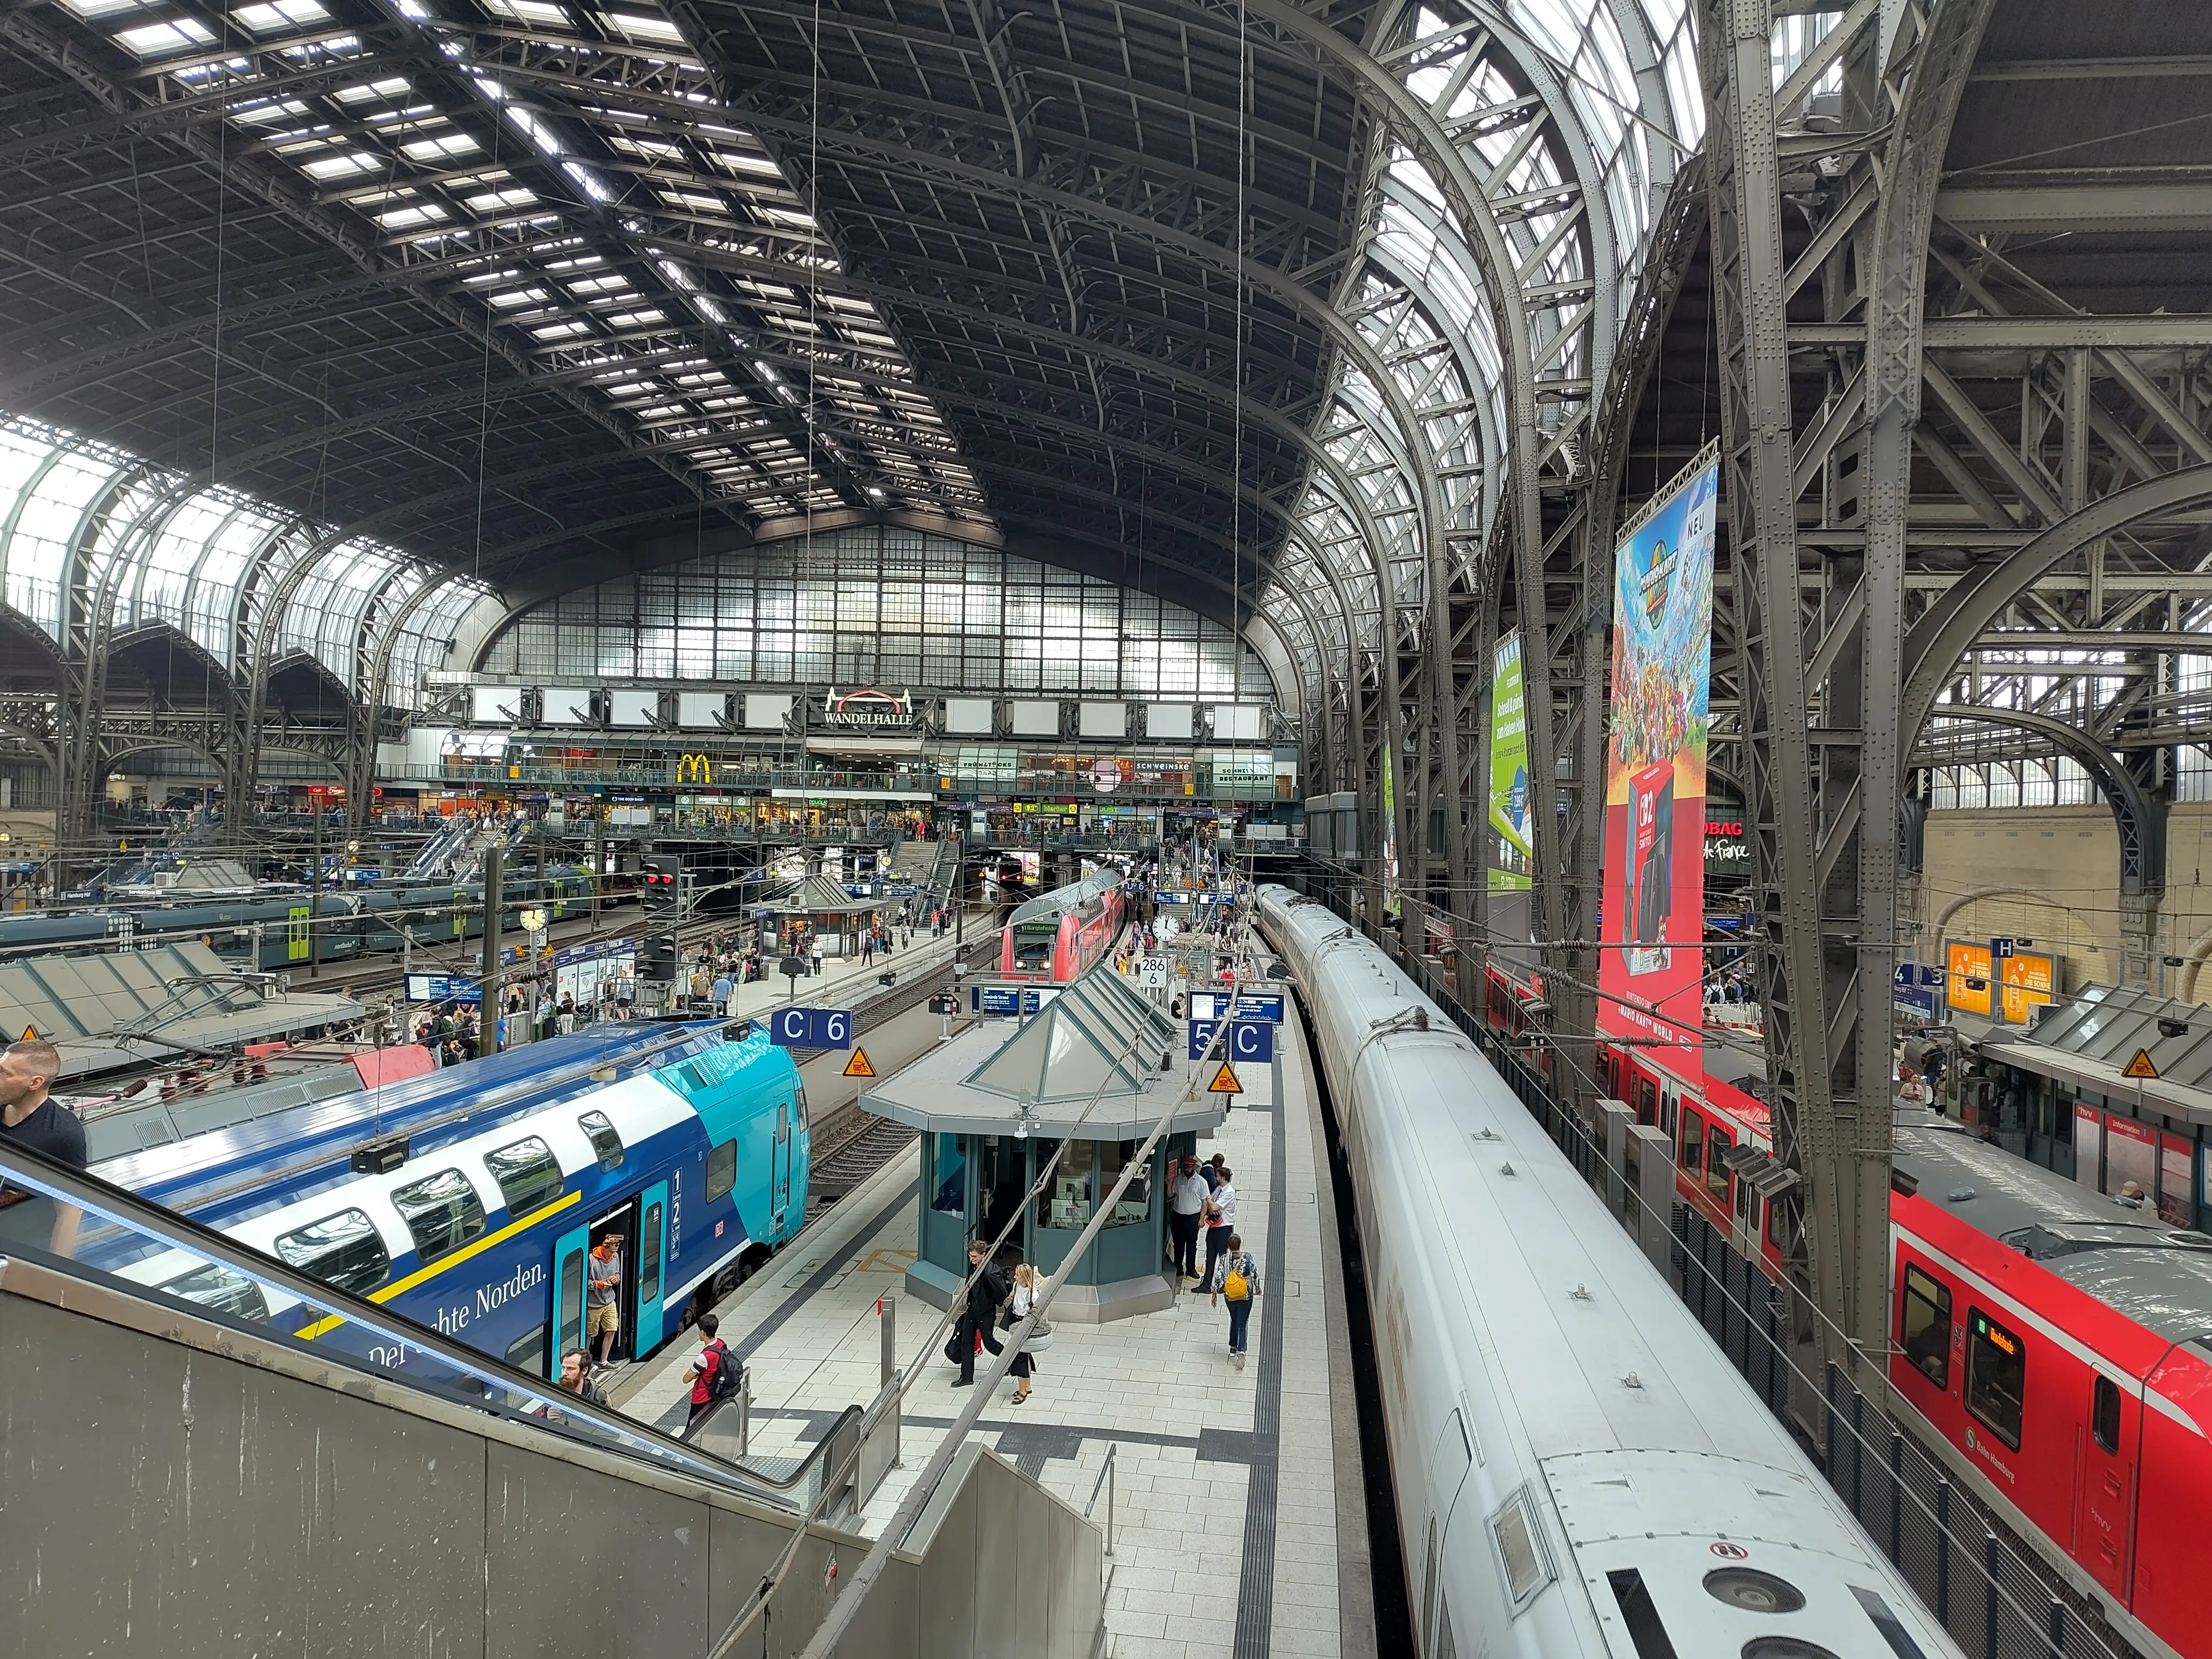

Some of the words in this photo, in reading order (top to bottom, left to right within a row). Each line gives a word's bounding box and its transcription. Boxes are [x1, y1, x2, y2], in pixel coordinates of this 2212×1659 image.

[1687, 511, 1705, 540] NEU
[824, 713, 913, 725] WANDELHALLE
[1639, 836, 1651, 849] SWITCH
[1714, 839, 1750, 861] France
[172, 852, 180, 860] 12
[2000, 941, 2012, 956] H
[1142, 959, 1165, 972] 286
[1748, 963, 1754, 973] H
[1976, 969, 1991, 978] SONNE
[1149, 973, 1157, 984] 6
[1894, 966, 1904, 982] 4
[2025, 978, 2033, 986] DIE
[2033, 980, 2051, 990] SONNE
[1626, 990, 1644, 1006] NINTENDO
[784, 1011, 804, 1038] C
[827, 1013, 845, 1041] 6
[1653, 1021, 1673, 1041] WORLD
[1195, 1024, 1212, 1051] 5
[1237, 1025, 1258, 1053] C
[2113, 1120, 2140, 1136] Information
[675, 1170, 679, 1191] 1
[673, 1202, 679, 1224] 2
[716, 1222, 723, 1236] DB
[475, 1263, 547, 1319] Norden.
[1967, 1429, 1974, 1449] S
[1977, 1440, 1990, 1459] Bahn
[1990, 1453, 2015, 1485] Hamburg
